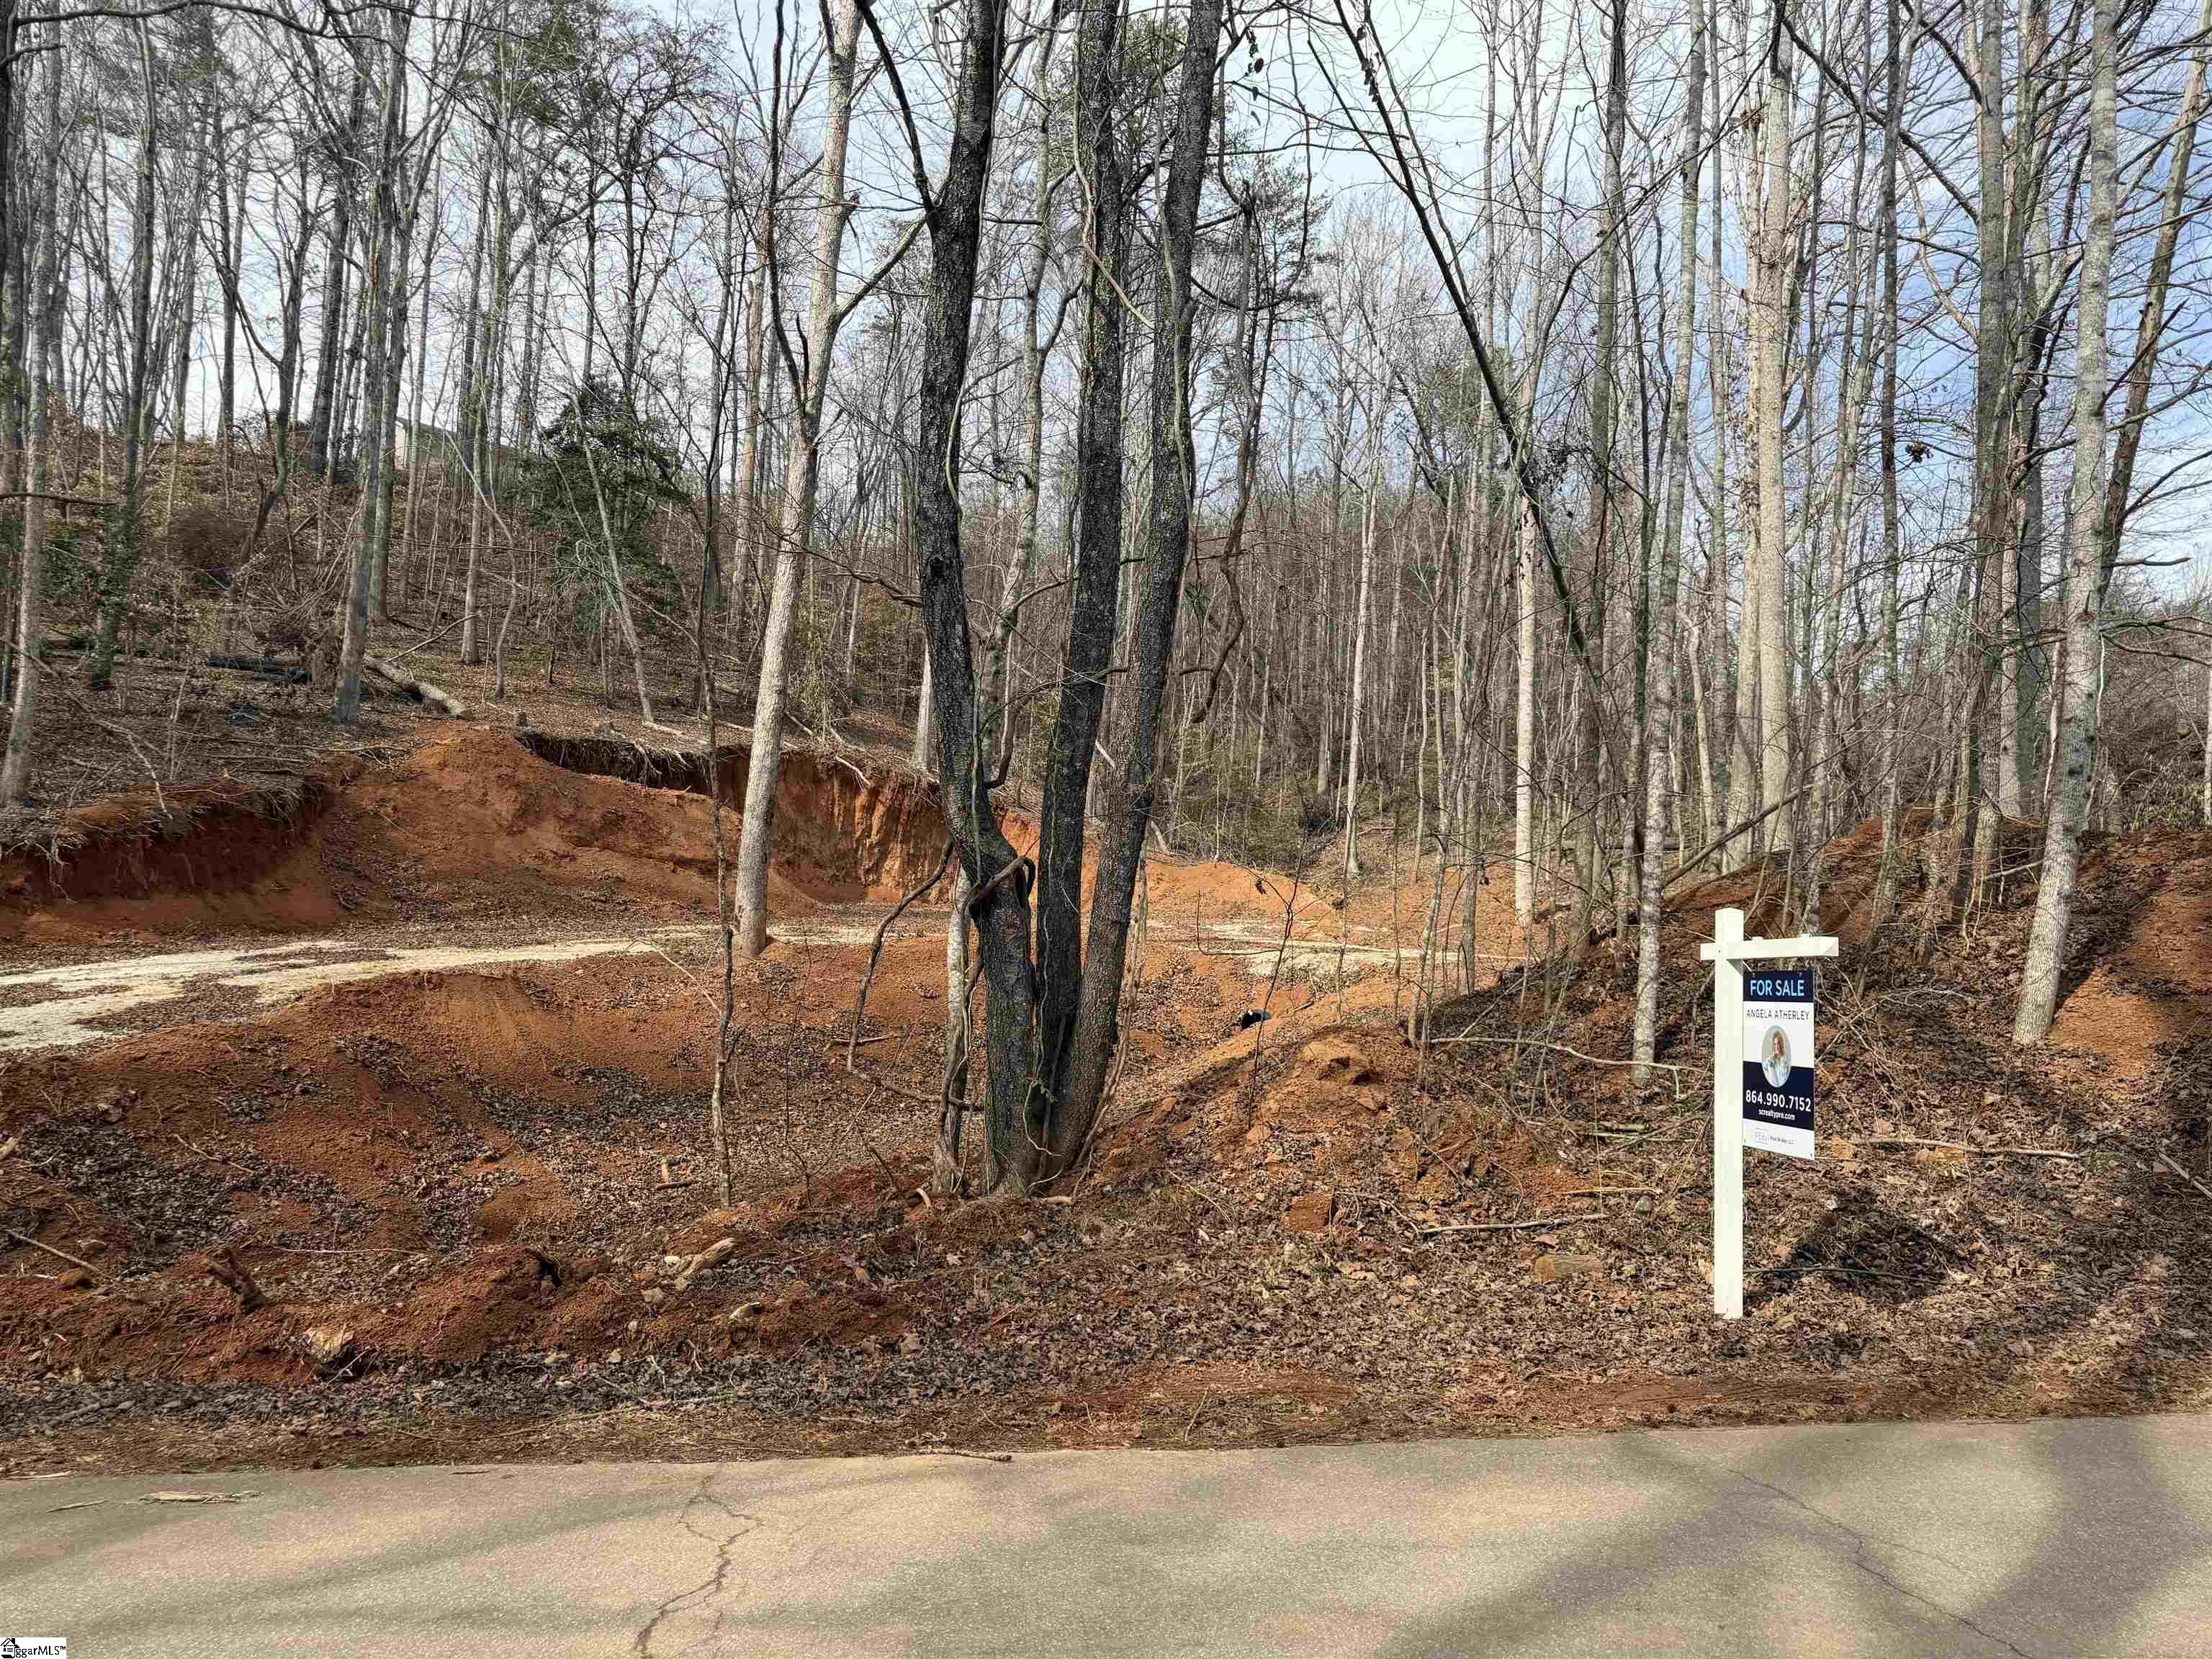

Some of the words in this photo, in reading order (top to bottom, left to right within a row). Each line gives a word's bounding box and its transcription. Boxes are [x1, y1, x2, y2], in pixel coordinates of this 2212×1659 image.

[1750, 979, 1773, 996] FOR
[1775, 979, 1805, 997] SALE
[1746, 1008, 1772, 1019] ANGELA
[1774, 1010, 1809, 1020] ATHERLEY
[1745, 1089, 1812, 1112] 864.990.7152
